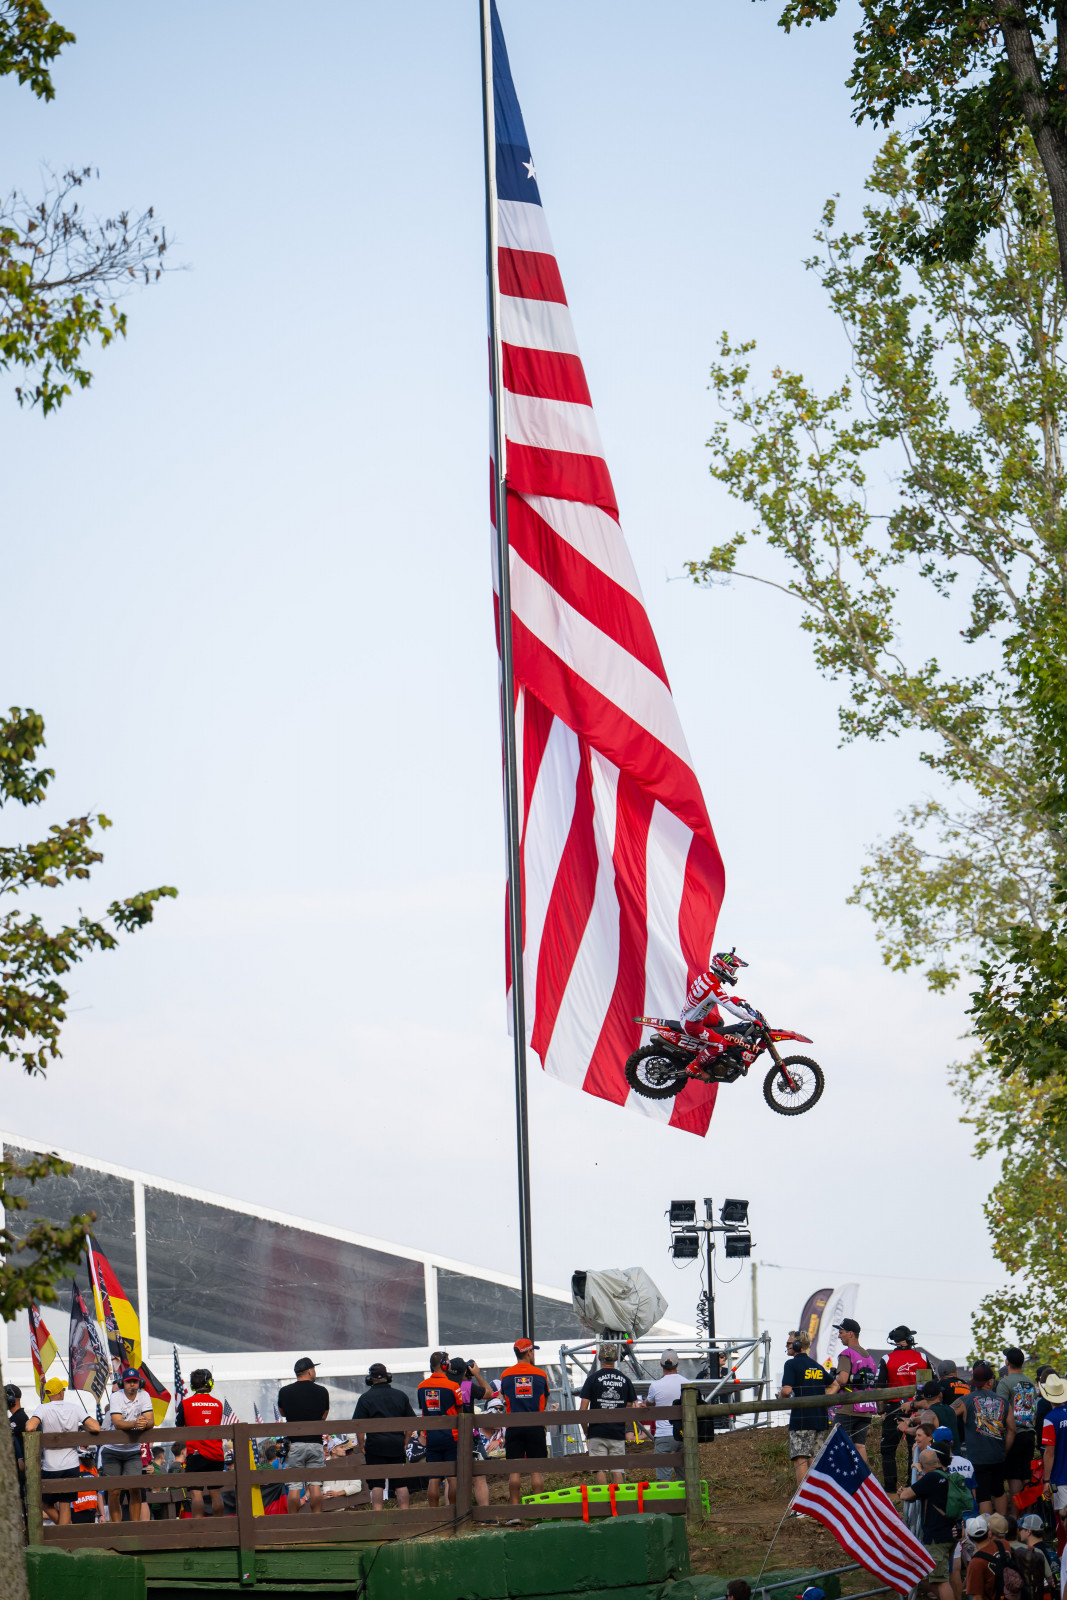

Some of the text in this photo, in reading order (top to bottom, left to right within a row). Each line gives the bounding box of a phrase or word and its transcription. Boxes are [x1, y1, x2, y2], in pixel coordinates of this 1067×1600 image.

[597, 1373, 626, 1384] SALT FLATS
[804, 1369, 823, 1380] SWE
[602, 1380, 623, 1388] RACING
